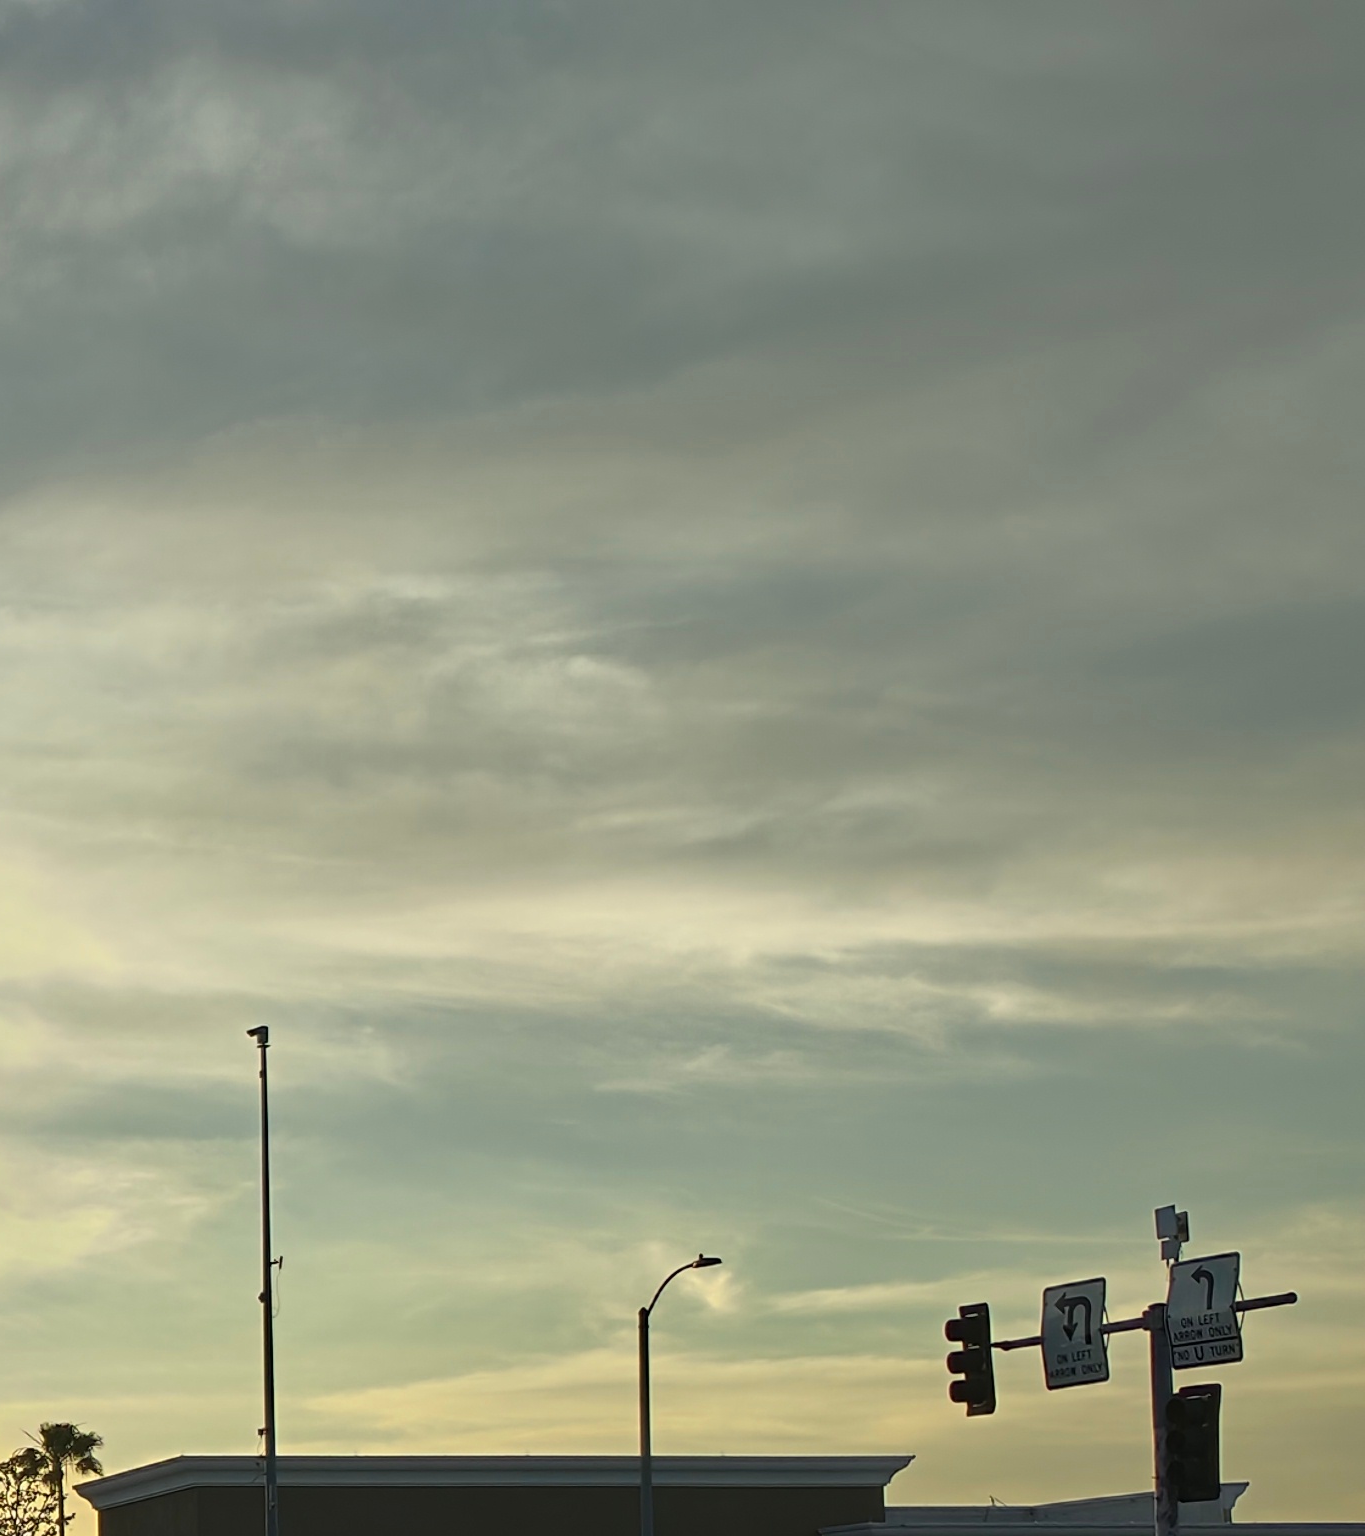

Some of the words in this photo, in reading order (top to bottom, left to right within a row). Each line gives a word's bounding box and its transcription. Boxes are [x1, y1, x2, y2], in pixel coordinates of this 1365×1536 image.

[1181, 1318, 1193, 1328] ON
[1198, 1313, 1220, 1326] LEFT
[1174, 1329, 1203, 1342] ARROW
[1209, 1324, 1232, 1338] ONLY
[1072, 1349, 1091, 1362] LEFT
[1194, 1346, 1204, 1361] U
[1210, 1344, 1236, 1357] TURN
